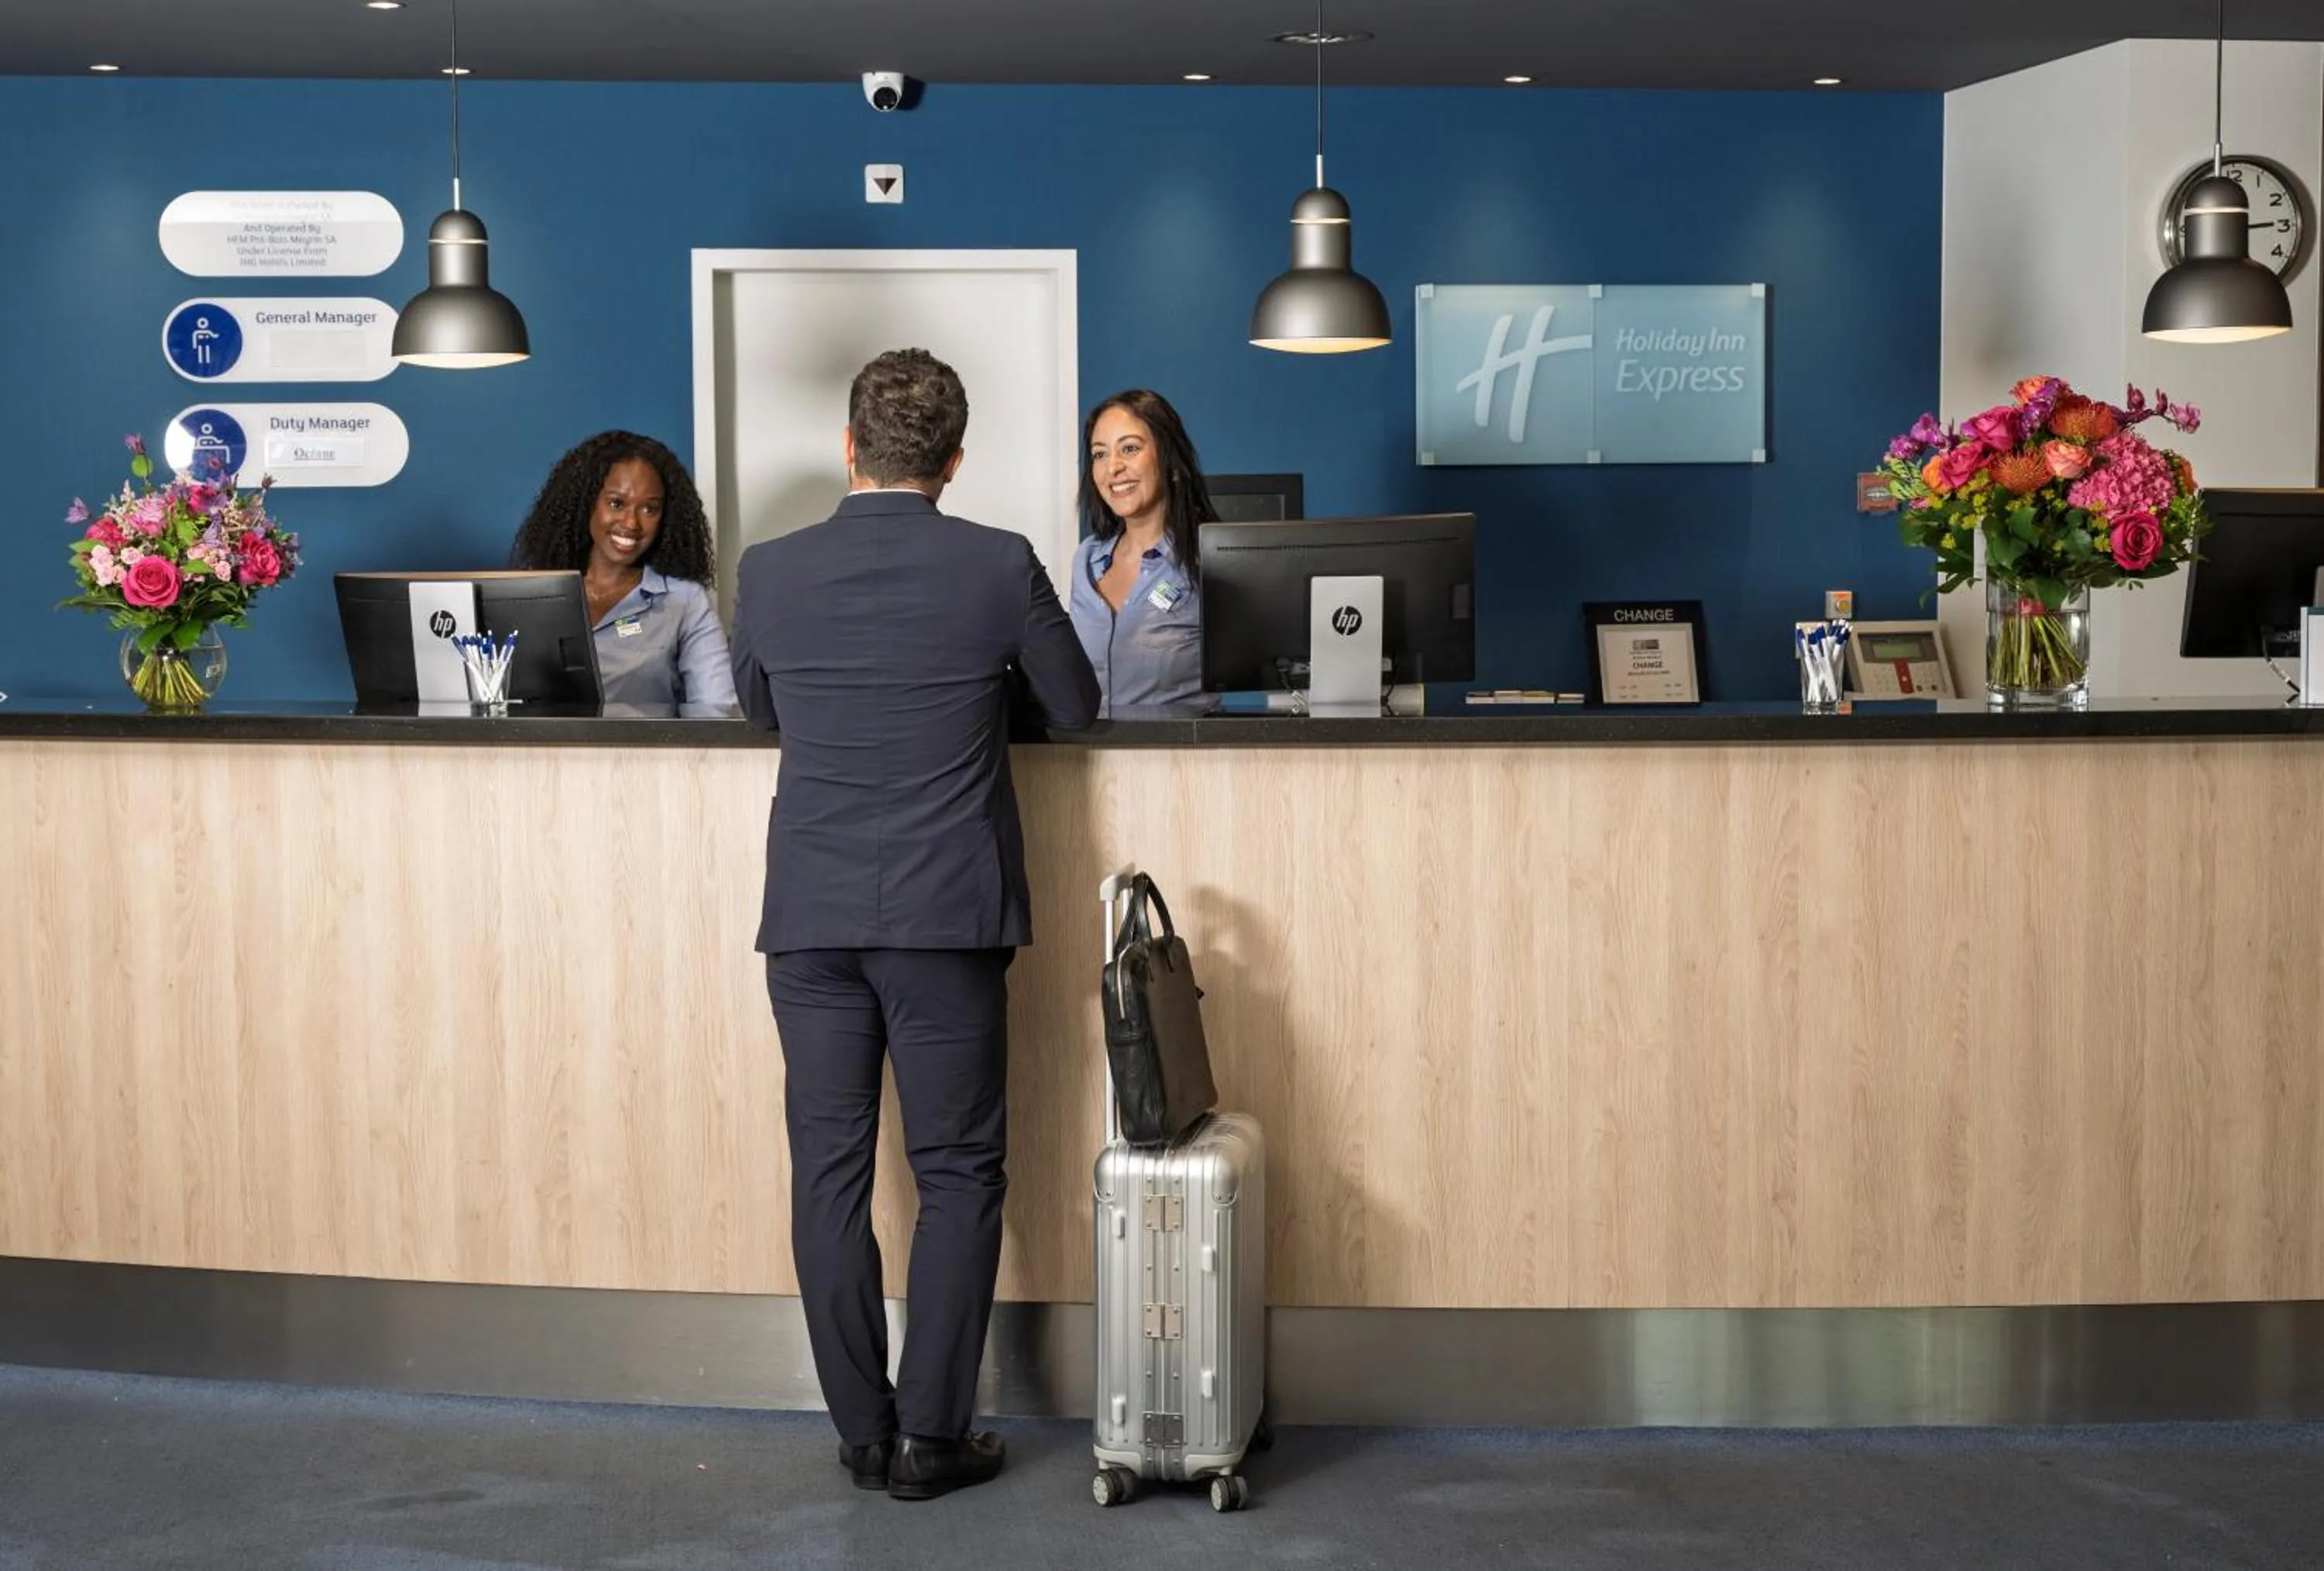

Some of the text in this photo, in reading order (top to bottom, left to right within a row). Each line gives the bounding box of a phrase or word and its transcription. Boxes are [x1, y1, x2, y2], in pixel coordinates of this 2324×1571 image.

[2256, 174, 2260, 188] 1
[2269, 194, 2282, 207] 2
[264, 222, 306, 234] Operated
[2277, 219, 2291, 232] 3
[2271, 244, 2284, 257] 4
[255, 311, 377, 327] General Manager
[1614, 326, 1746, 356] Holiday Inn
[1615, 358, 1746, 402] Express
[270, 417, 370, 432] Duty Manager
[1336, 607, 1360, 635] hp
[1614, 608, 1674, 621] CHANGE
[432, 610, 454, 639] hp
